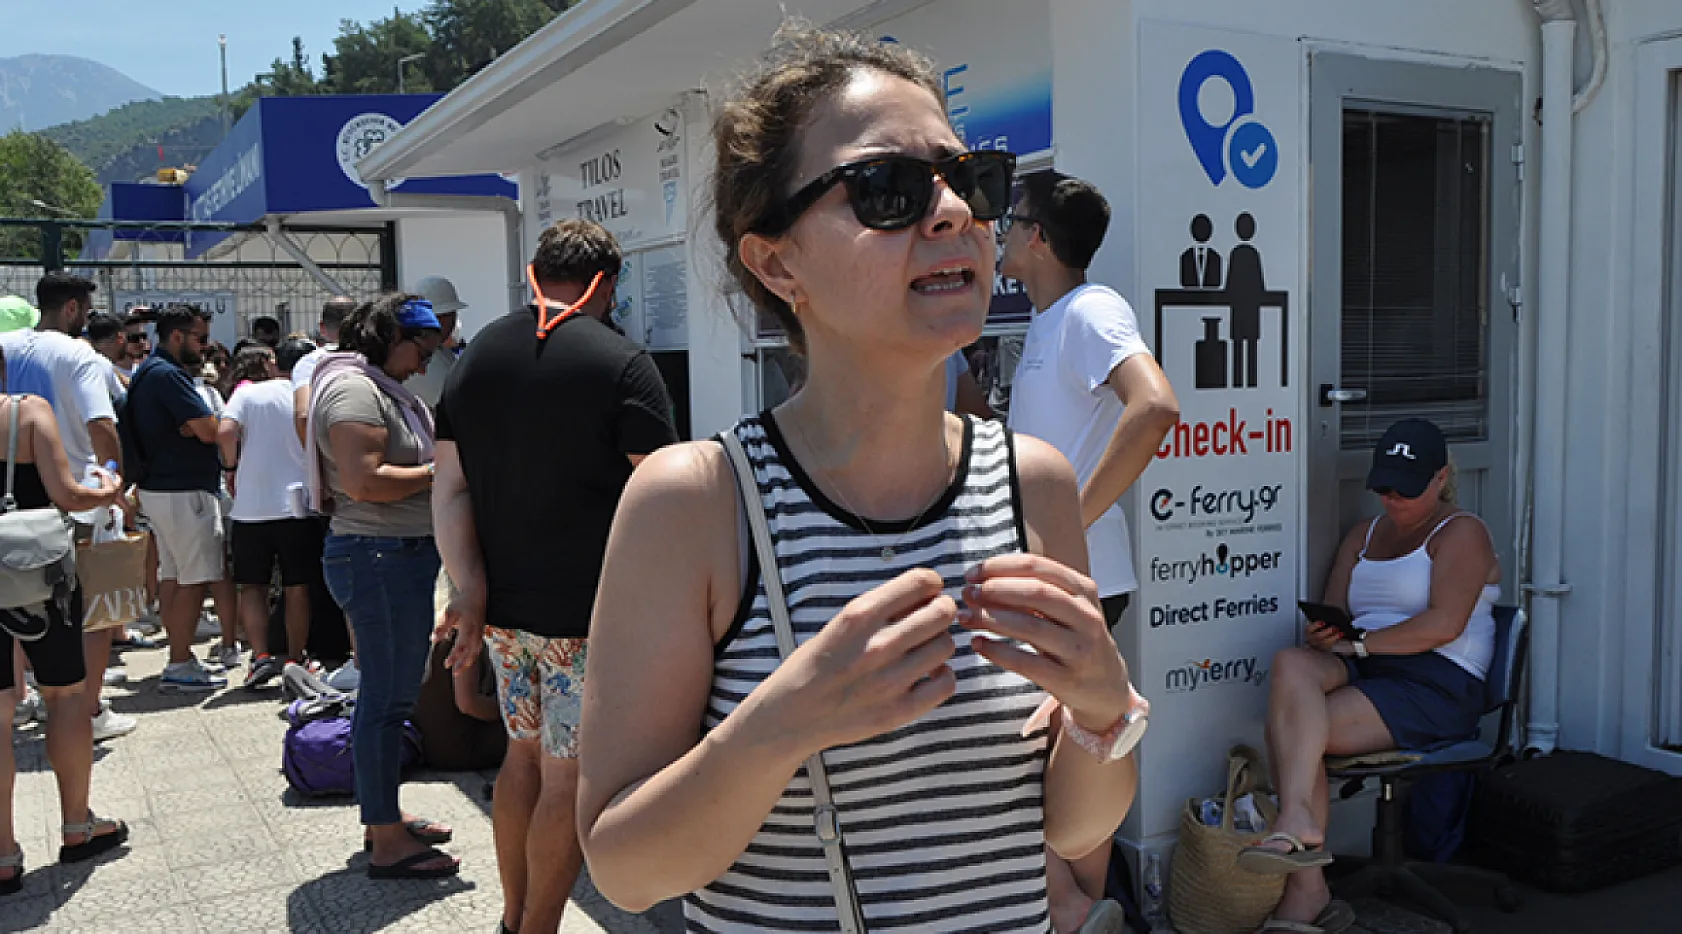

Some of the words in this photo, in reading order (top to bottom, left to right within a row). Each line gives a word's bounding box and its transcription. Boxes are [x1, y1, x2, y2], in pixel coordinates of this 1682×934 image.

[580, 148, 622, 189] TILOS
[577, 188, 628, 222] TRAVEL
[1150, 601, 1209, 628] Direct
[1214, 594, 1279, 618] Ferries
